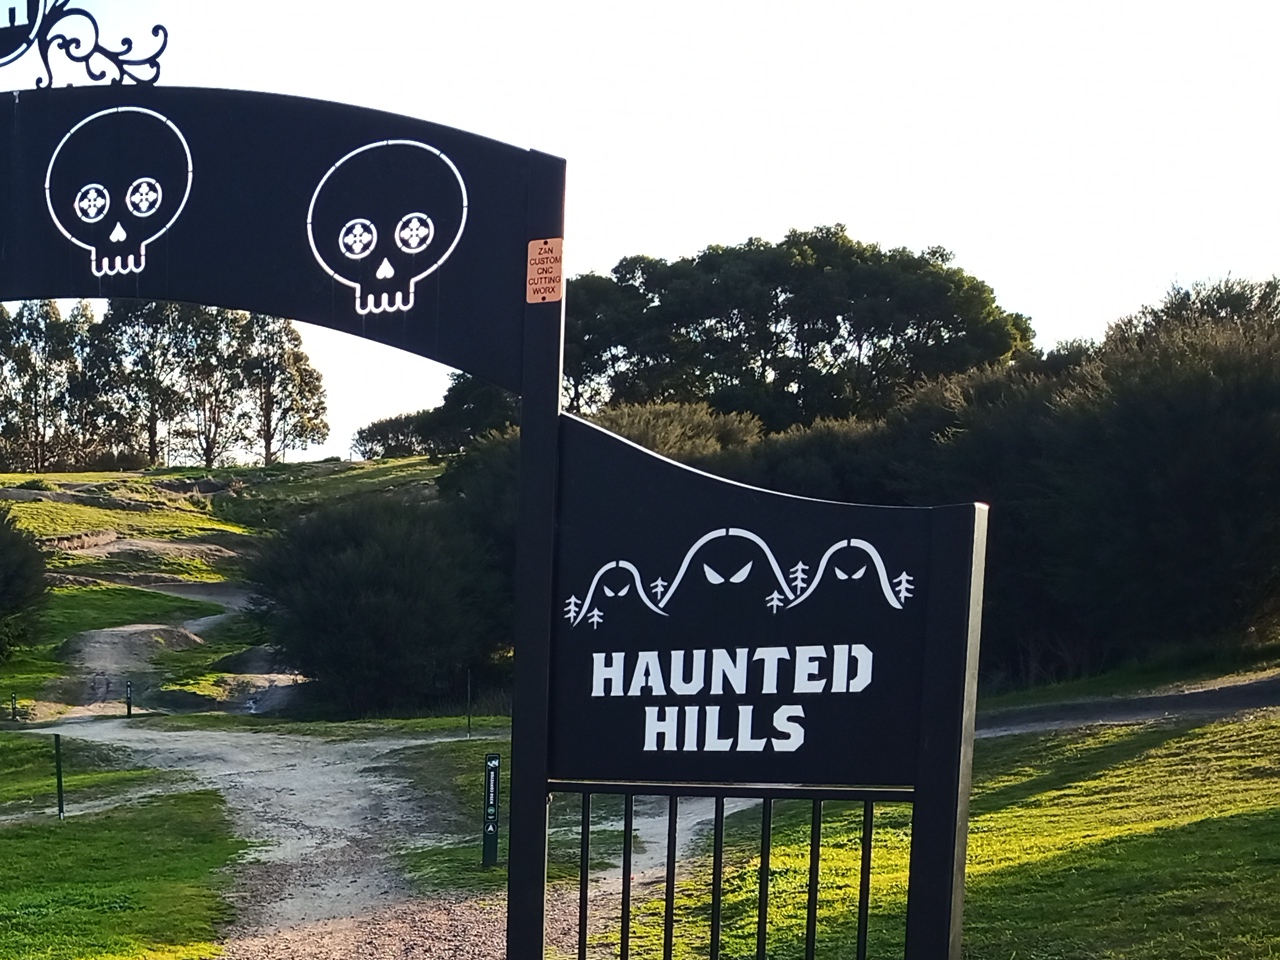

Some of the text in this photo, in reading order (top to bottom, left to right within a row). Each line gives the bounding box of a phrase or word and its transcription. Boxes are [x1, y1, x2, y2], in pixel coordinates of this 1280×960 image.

[529, 256, 561, 266] CUSTOM
[536, 266, 553, 275] CNC
[528, 275, 561, 286] CUTTING
[532, 286, 556, 295] WORX
[590, 643, 874, 697] HAUNTED
[643, 704, 806, 752] HILLS
